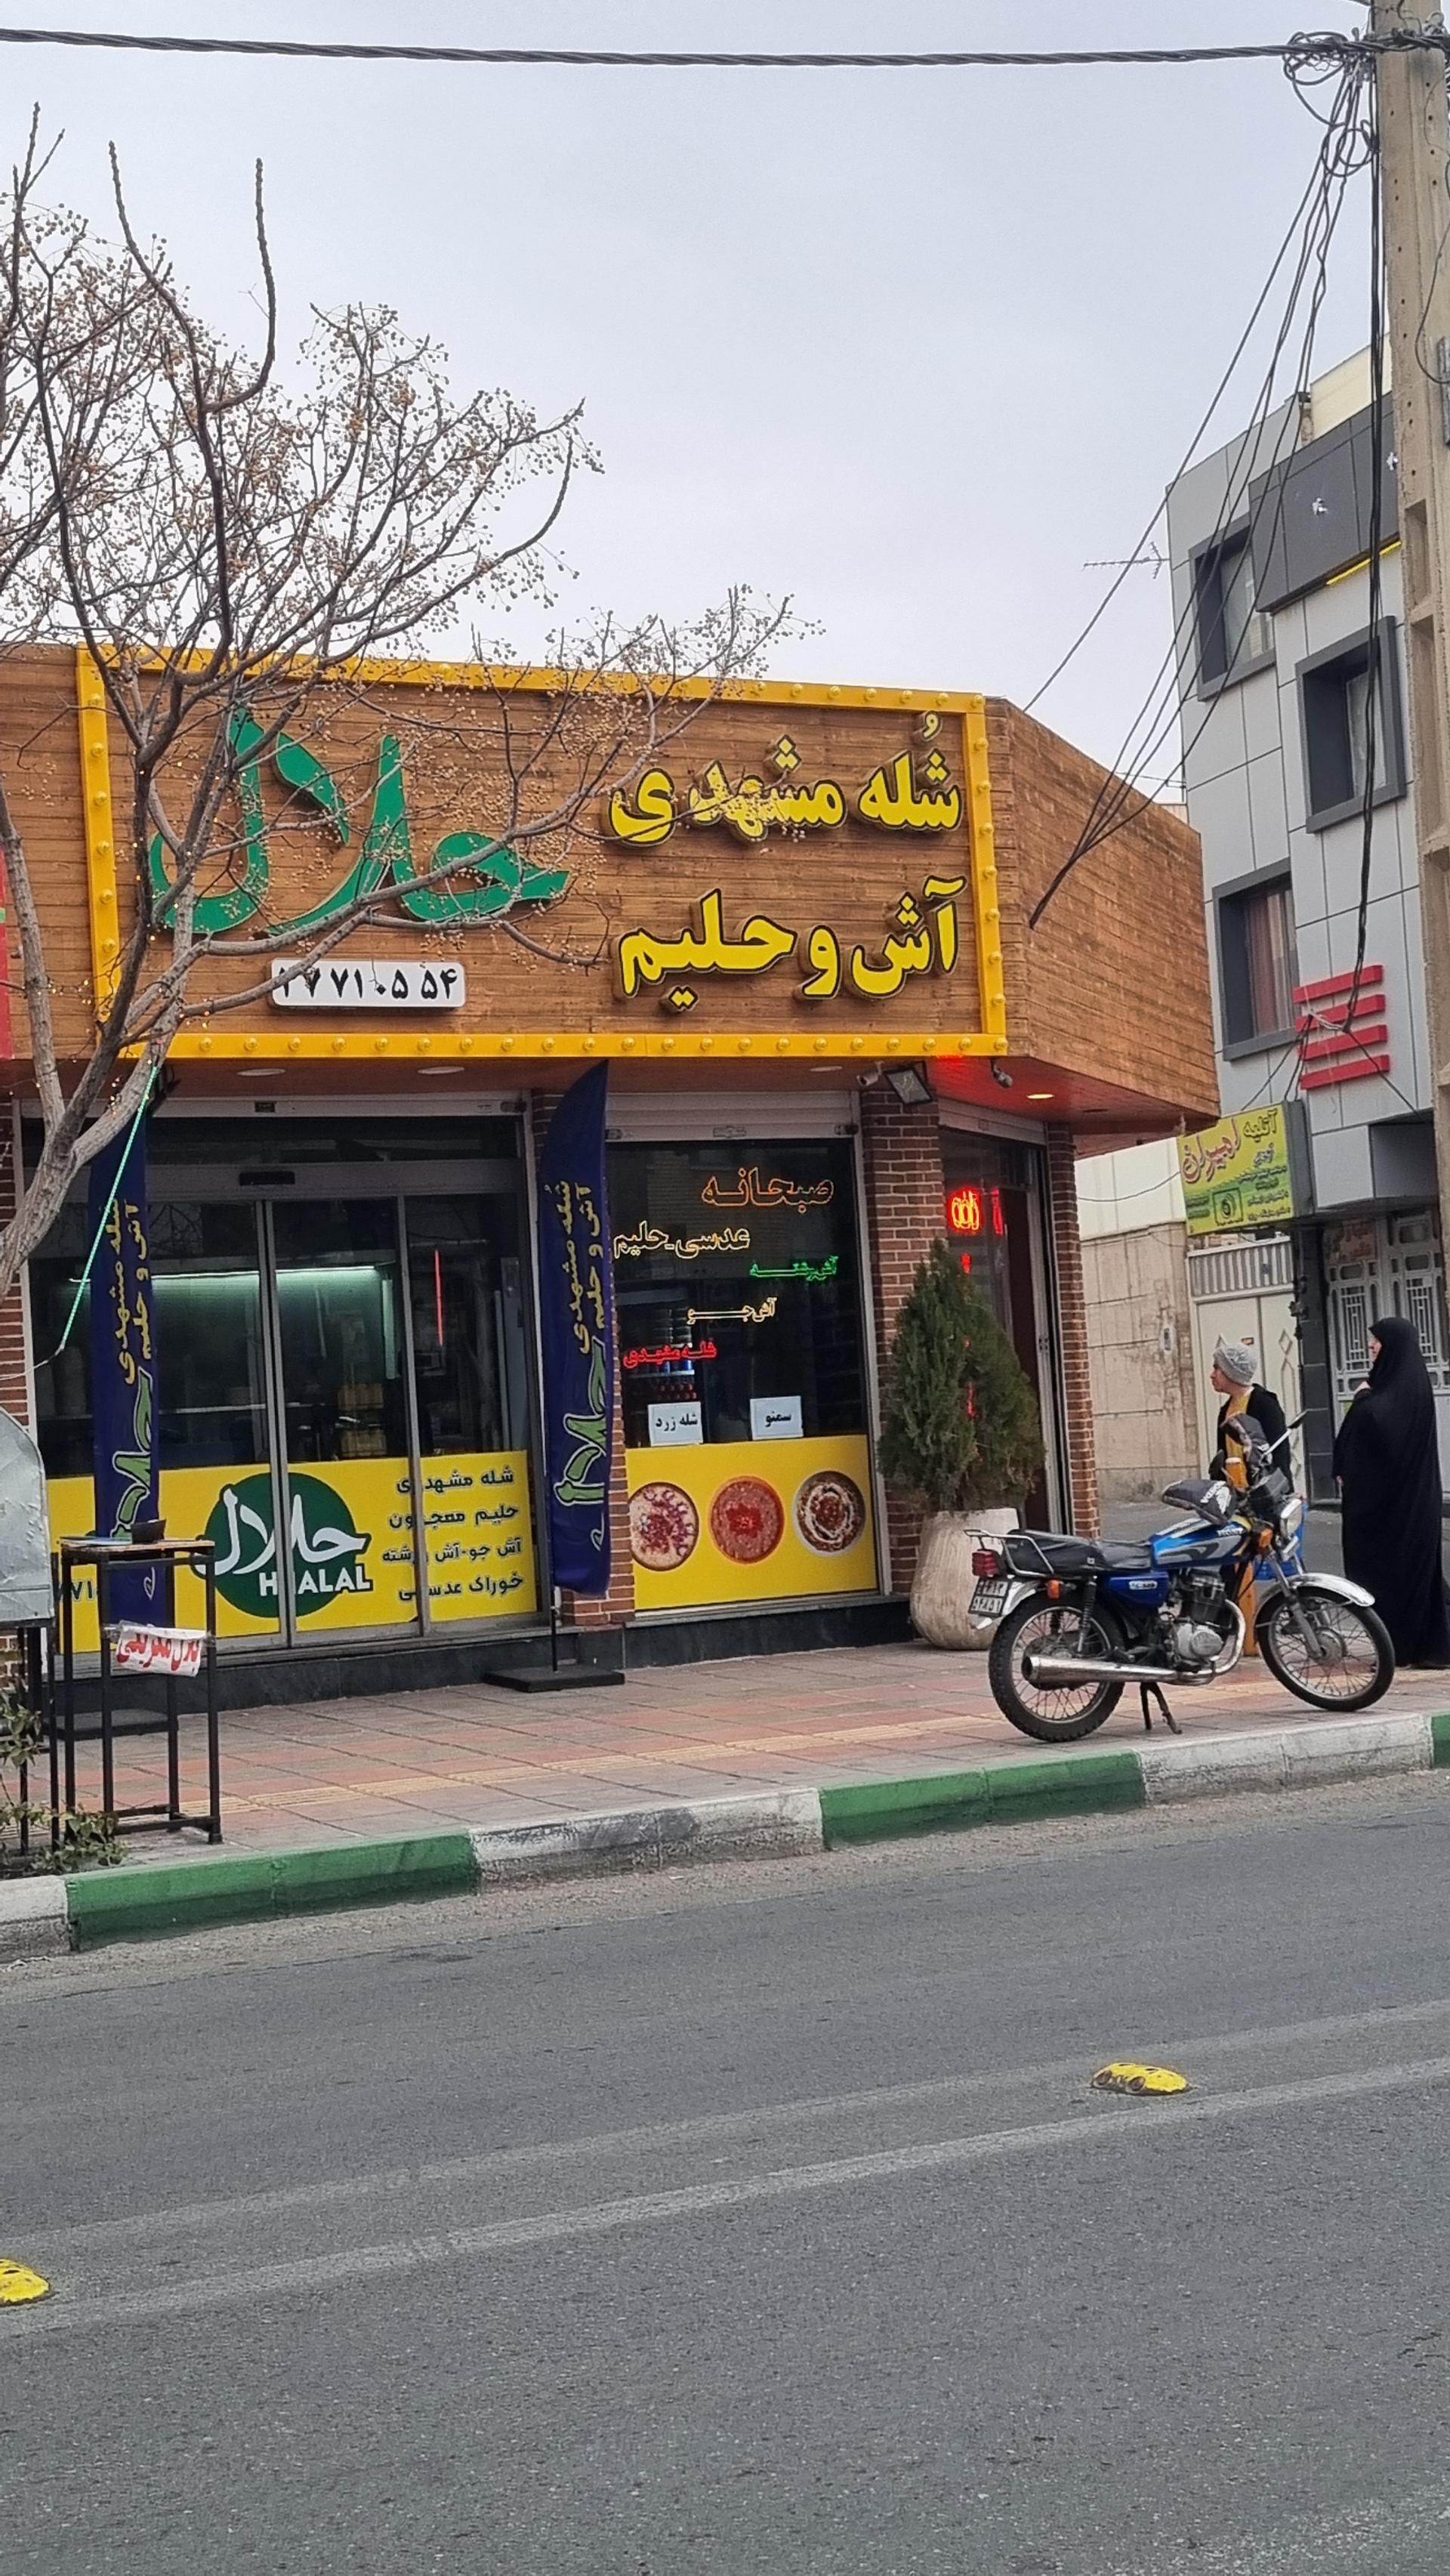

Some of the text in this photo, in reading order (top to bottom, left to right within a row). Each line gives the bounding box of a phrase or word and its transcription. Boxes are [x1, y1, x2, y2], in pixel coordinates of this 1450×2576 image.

[609, 735, 847, 845] مشهدی
[619, 876, 967, 1012] آش و حلیم
[702, 1167, 835, 1213] صبحانه
[123, 1198, 148, 1261] آش
[575, 1182, 601, 1237] آش
[588, 1243, 604, 1260] و
[135, 1267, 150, 1282] و
[562, 1240, 591, 1355] مشهدی
[109, 1260, 136, 1385] مشهدی
[655, 1412, 699, 1432] شله زرد
[764, 1413, 792, 1428] سمنو
[396, 1465, 514, 1493] شله مشهدی
[194, 1488, 367, 1576] حلال
[475, 1505, 519, 1526] حلیم
[497, 1537, 522, 1557] آش
[258, 1565, 371, 1597] HALAL
[398, 1571, 523, 1602] خوراک عدسی
